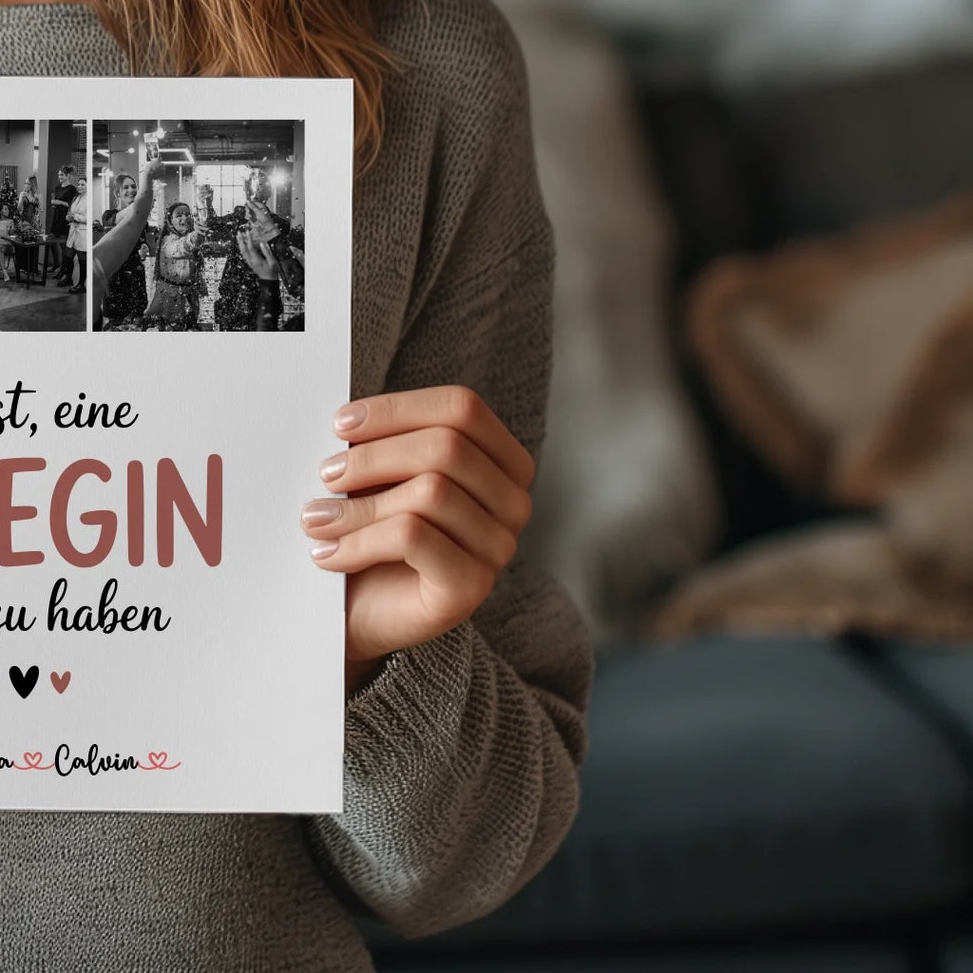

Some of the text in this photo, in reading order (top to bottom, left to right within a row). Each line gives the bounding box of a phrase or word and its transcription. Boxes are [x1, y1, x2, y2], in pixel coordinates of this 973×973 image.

[54, 392, 139, 429] eine
[47, 577, 172, 634] haben
[54, 743, 139, 777] Calvin
